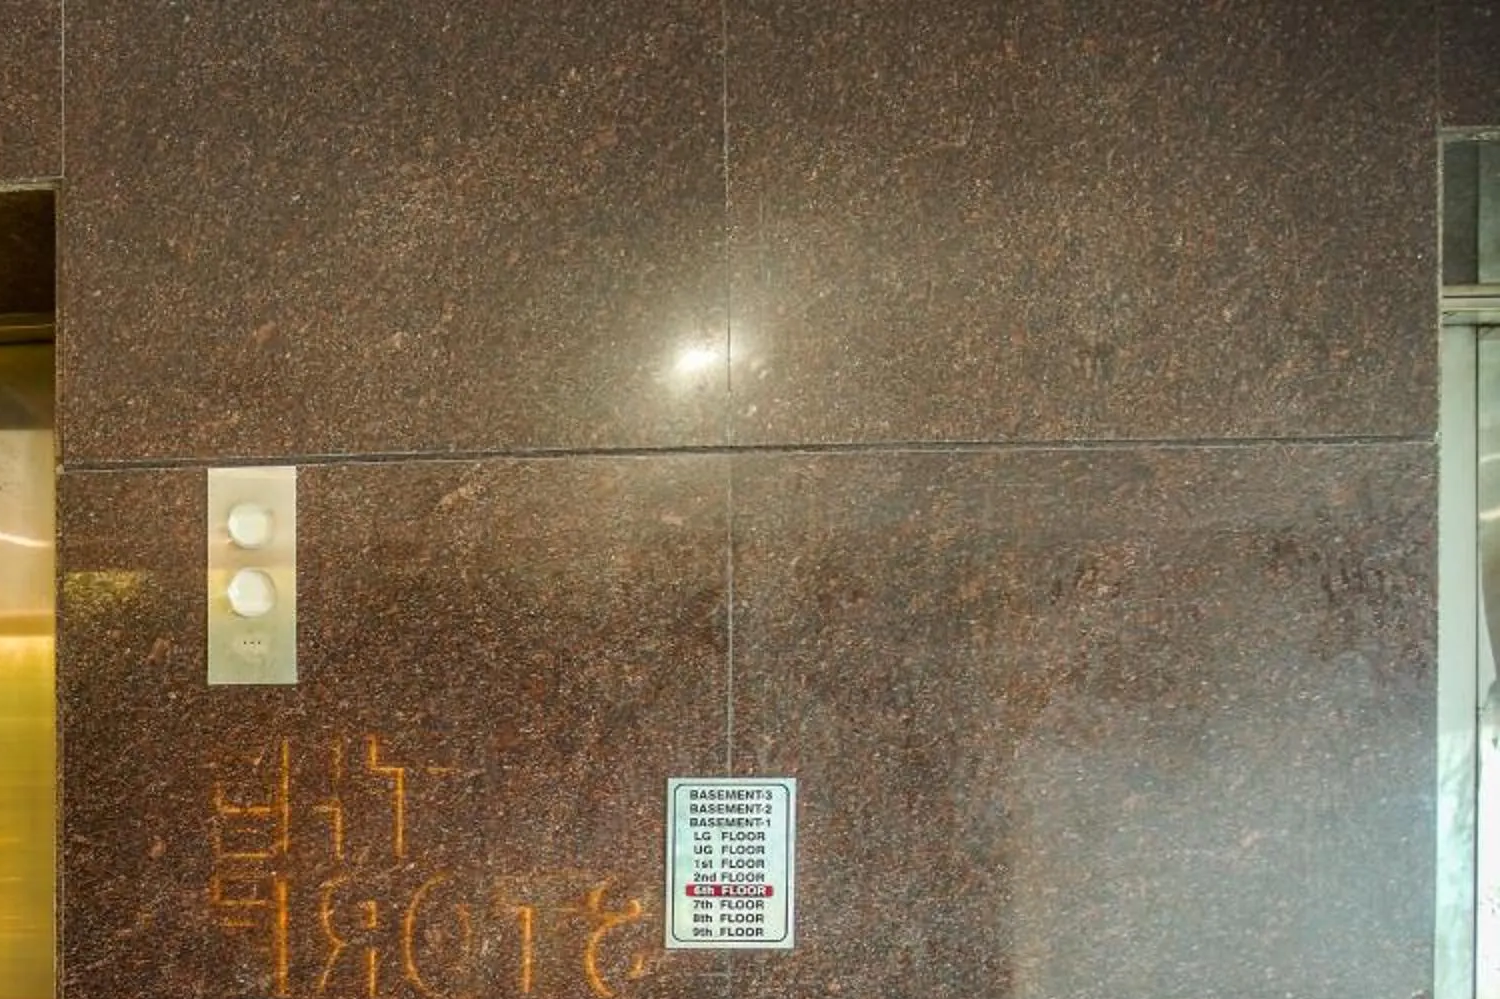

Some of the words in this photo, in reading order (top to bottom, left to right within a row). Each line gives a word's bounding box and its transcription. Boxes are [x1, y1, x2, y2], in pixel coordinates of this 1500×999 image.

[689, 789, 773, 800] BASEMENT-3
[689, 803, 773, 814] BASEMENT-2
[689, 817, 772, 828] BASEMENT-1
[693, 832, 712, 841] LG
[721, 832, 766, 841] FLOOR
[693, 845, 713, 855] UG
[721, 845, 766, 855] FLOOR
[693, 859, 713, 869] 1st
[721, 859, 765, 869] FLOOR
[693, 872, 717, 883] 2nd
[721, 872, 765, 883] FLOOR
[722, 886, 767, 896] FLOOR
[693, 900, 713, 909] 7th
[719, 900, 765, 909] FLOOR
[692, 914, 713, 923] 8th
[719, 914, 765, 923] FLOOR
[692, 927, 713, 937] 9th
[719, 927, 764, 937] FLOOR
